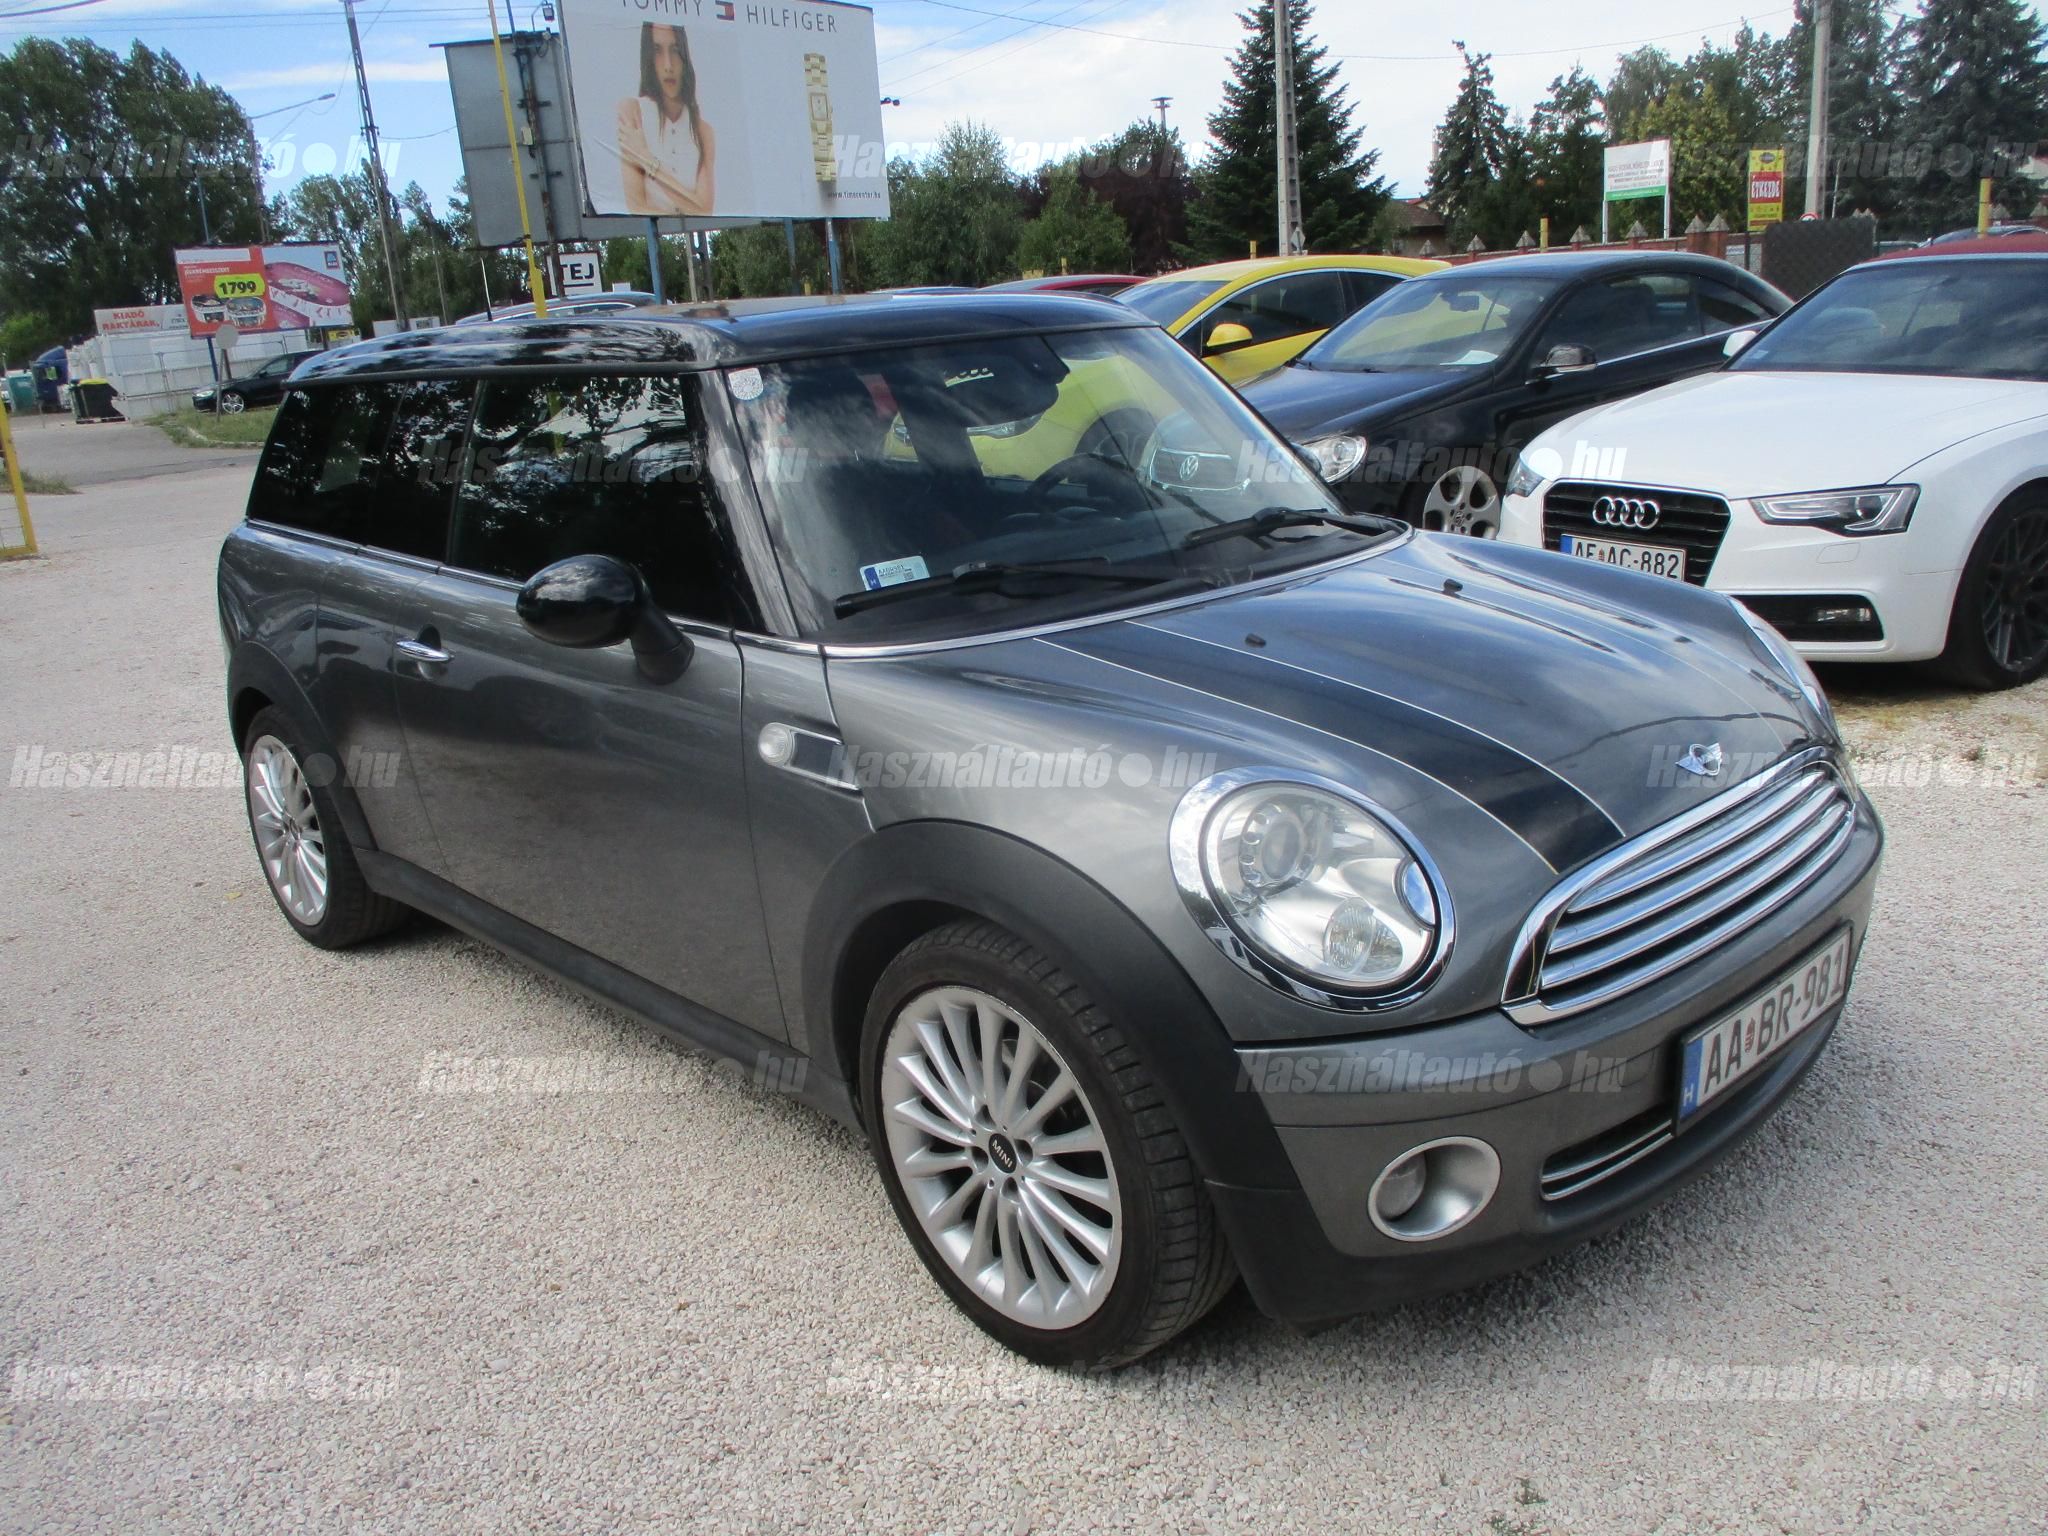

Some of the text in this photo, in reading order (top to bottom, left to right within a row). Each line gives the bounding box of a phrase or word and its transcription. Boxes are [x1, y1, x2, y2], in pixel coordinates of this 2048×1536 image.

[746, 4, 837, 33] HILFIGER
[219, 281, 257, 295] 1799
[992, 1140, 1013, 1168] MINI
